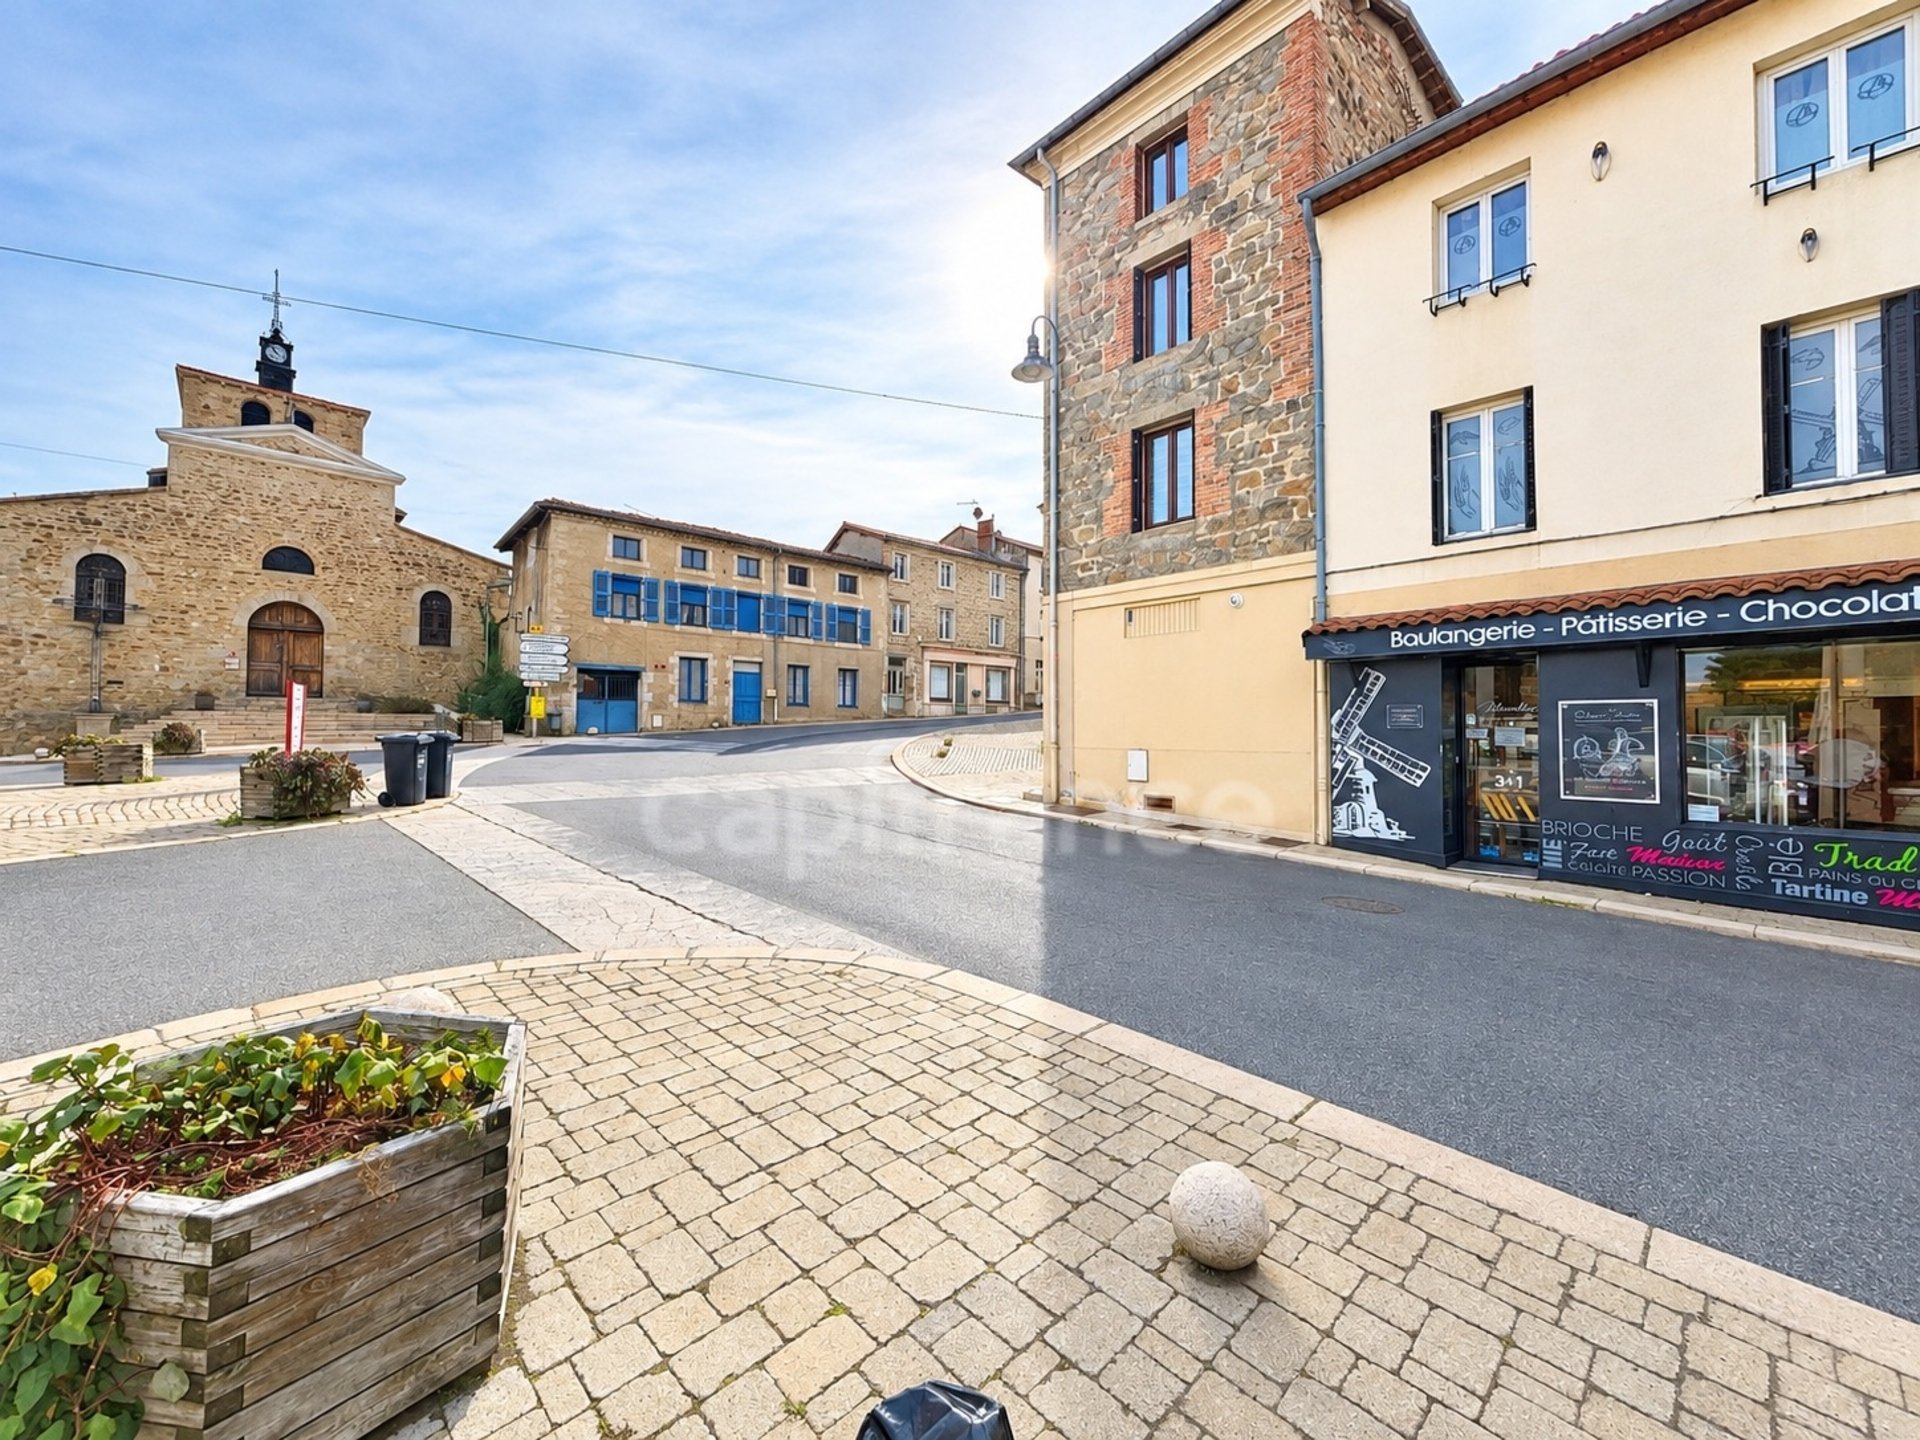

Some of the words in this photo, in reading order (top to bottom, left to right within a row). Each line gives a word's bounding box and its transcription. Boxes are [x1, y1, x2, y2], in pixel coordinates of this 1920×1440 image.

[1561, 606, 1708, 637] Pâtisserie
[1541, 820, 1644, 843] BRIOCHE
[1632, 865, 1726, 889] PASSION
[1808, 867, 1862, 885] PAINS
[1771, 878, 1869, 906] Tartine
